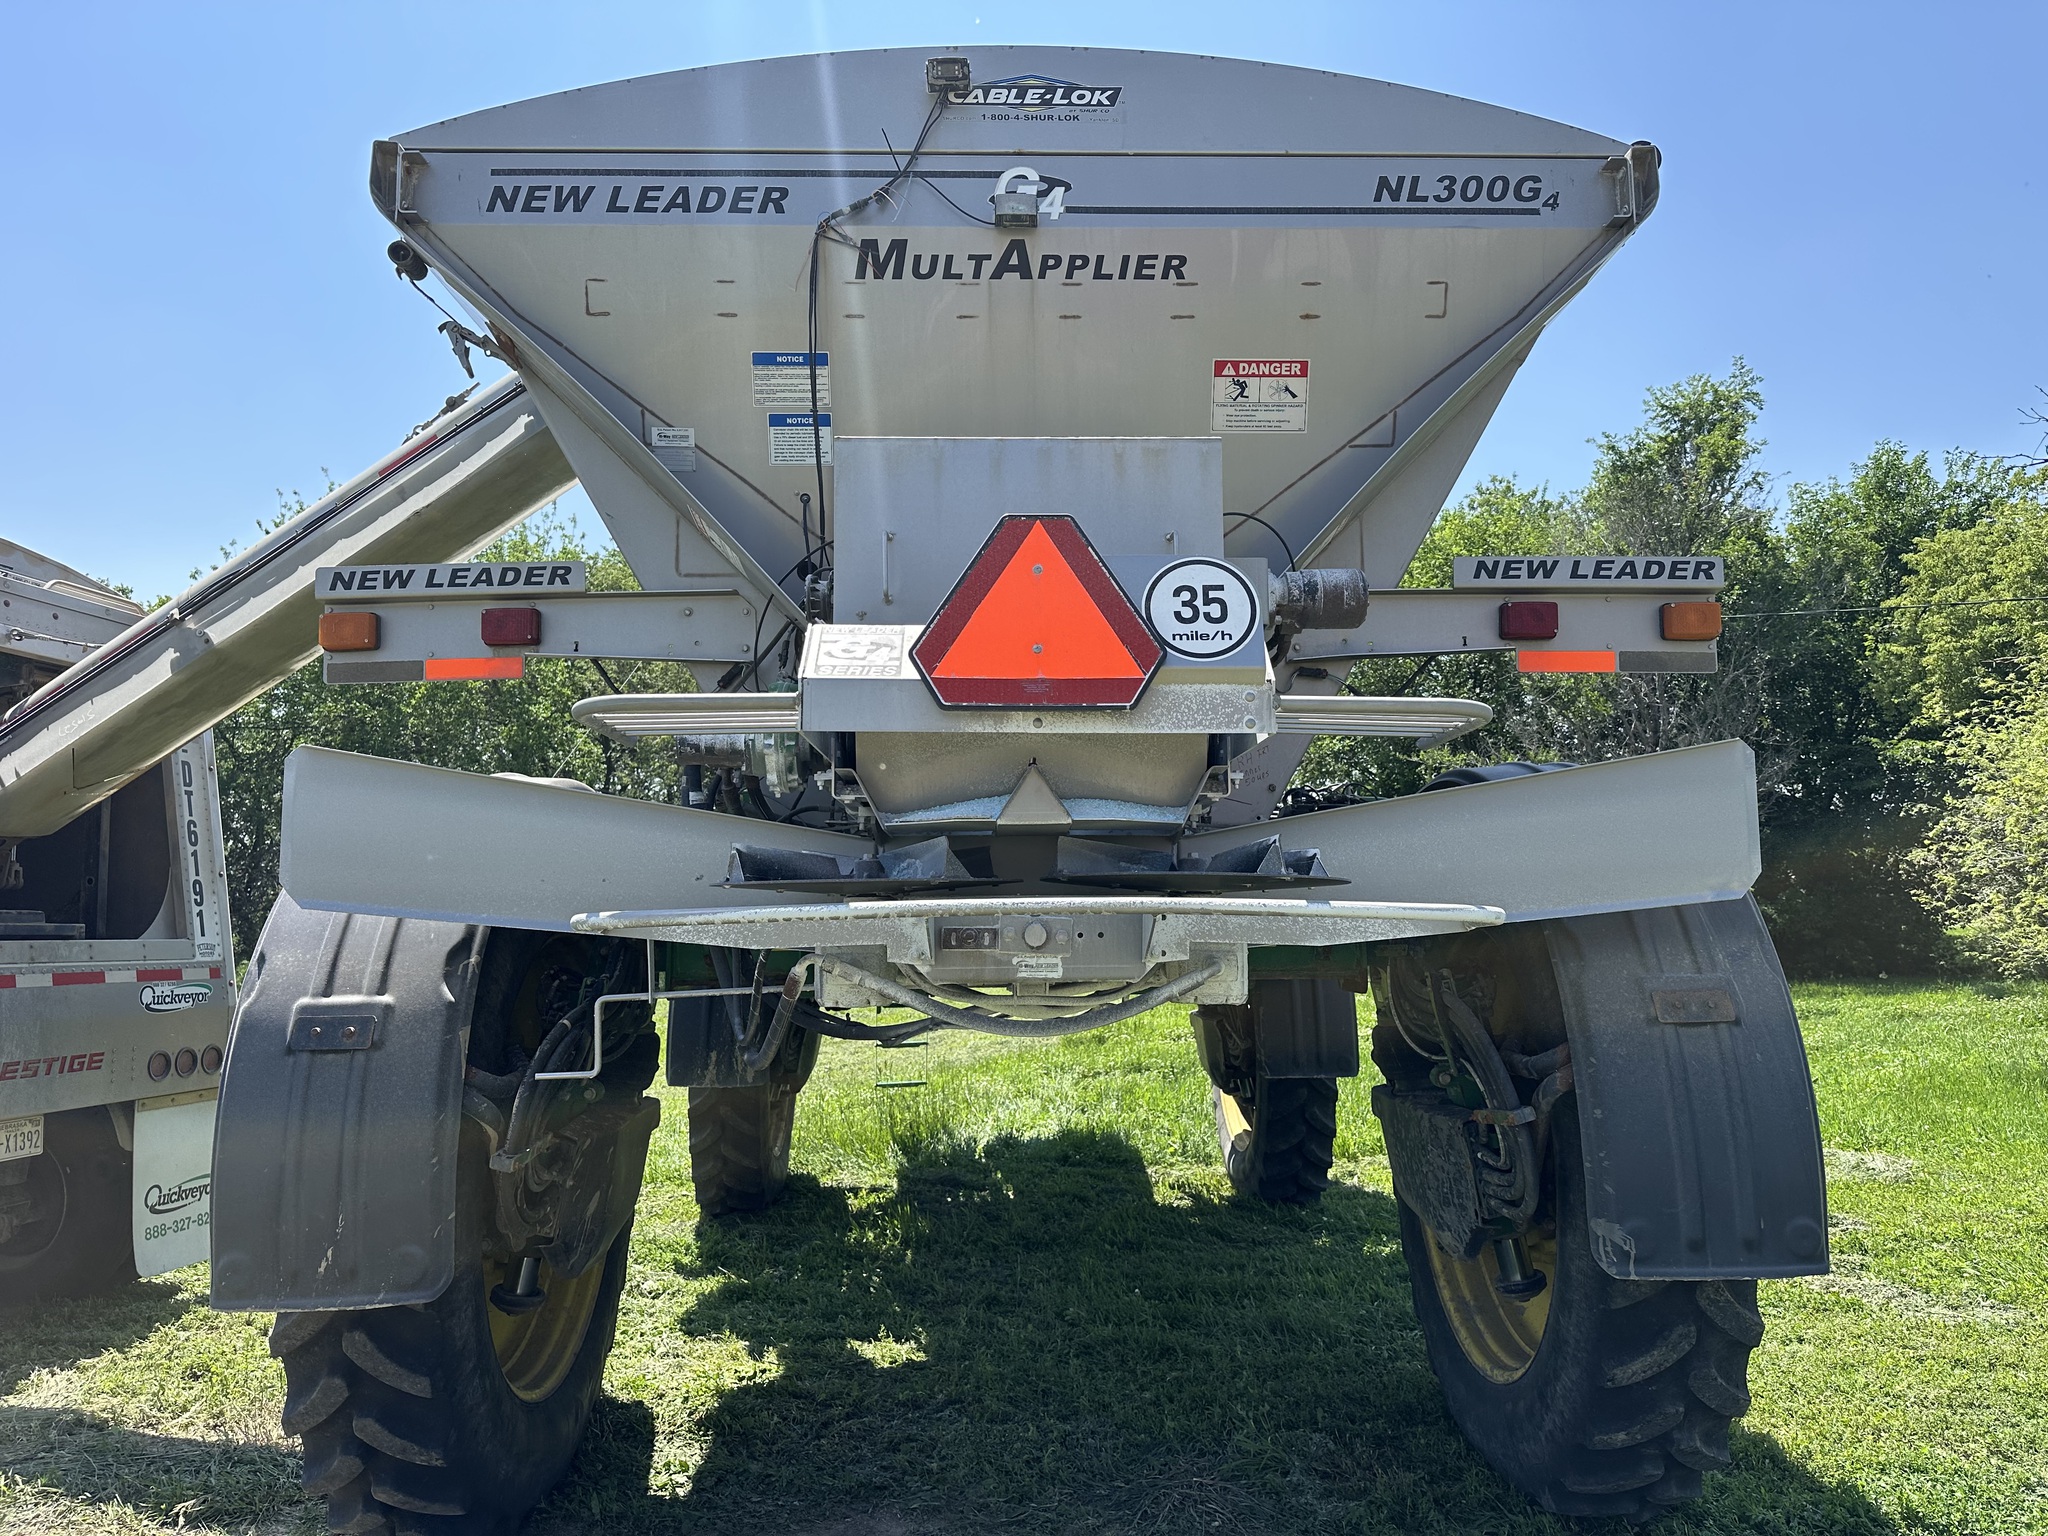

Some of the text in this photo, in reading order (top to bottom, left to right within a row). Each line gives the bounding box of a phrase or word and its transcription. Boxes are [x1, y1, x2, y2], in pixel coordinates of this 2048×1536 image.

[981, 113, 1080, 121] 1-800-4-SHUR-LOK
[485, 185, 790, 214] NEW LEADER
[1239, 363, 1301, 375] DANGER
[328, 565, 572, 591] NEW LEADER
[1473, 560, 1716, 581] NEW LEADER
[1172, 584, 1229, 624] 35
[1171, 630, 1233, 641] mile/h
[818, 665, 898, 676] SERIES
[139, 985, 210, 1012] Quickveyor
[0, 1052, 105, 1081] ESTIGE
[0, 1121, 27, 1131] EBRASKA
[144, 1183, 210, 1214] Quickveyo
[144, 1211, 210, 1241] 888-327-82
